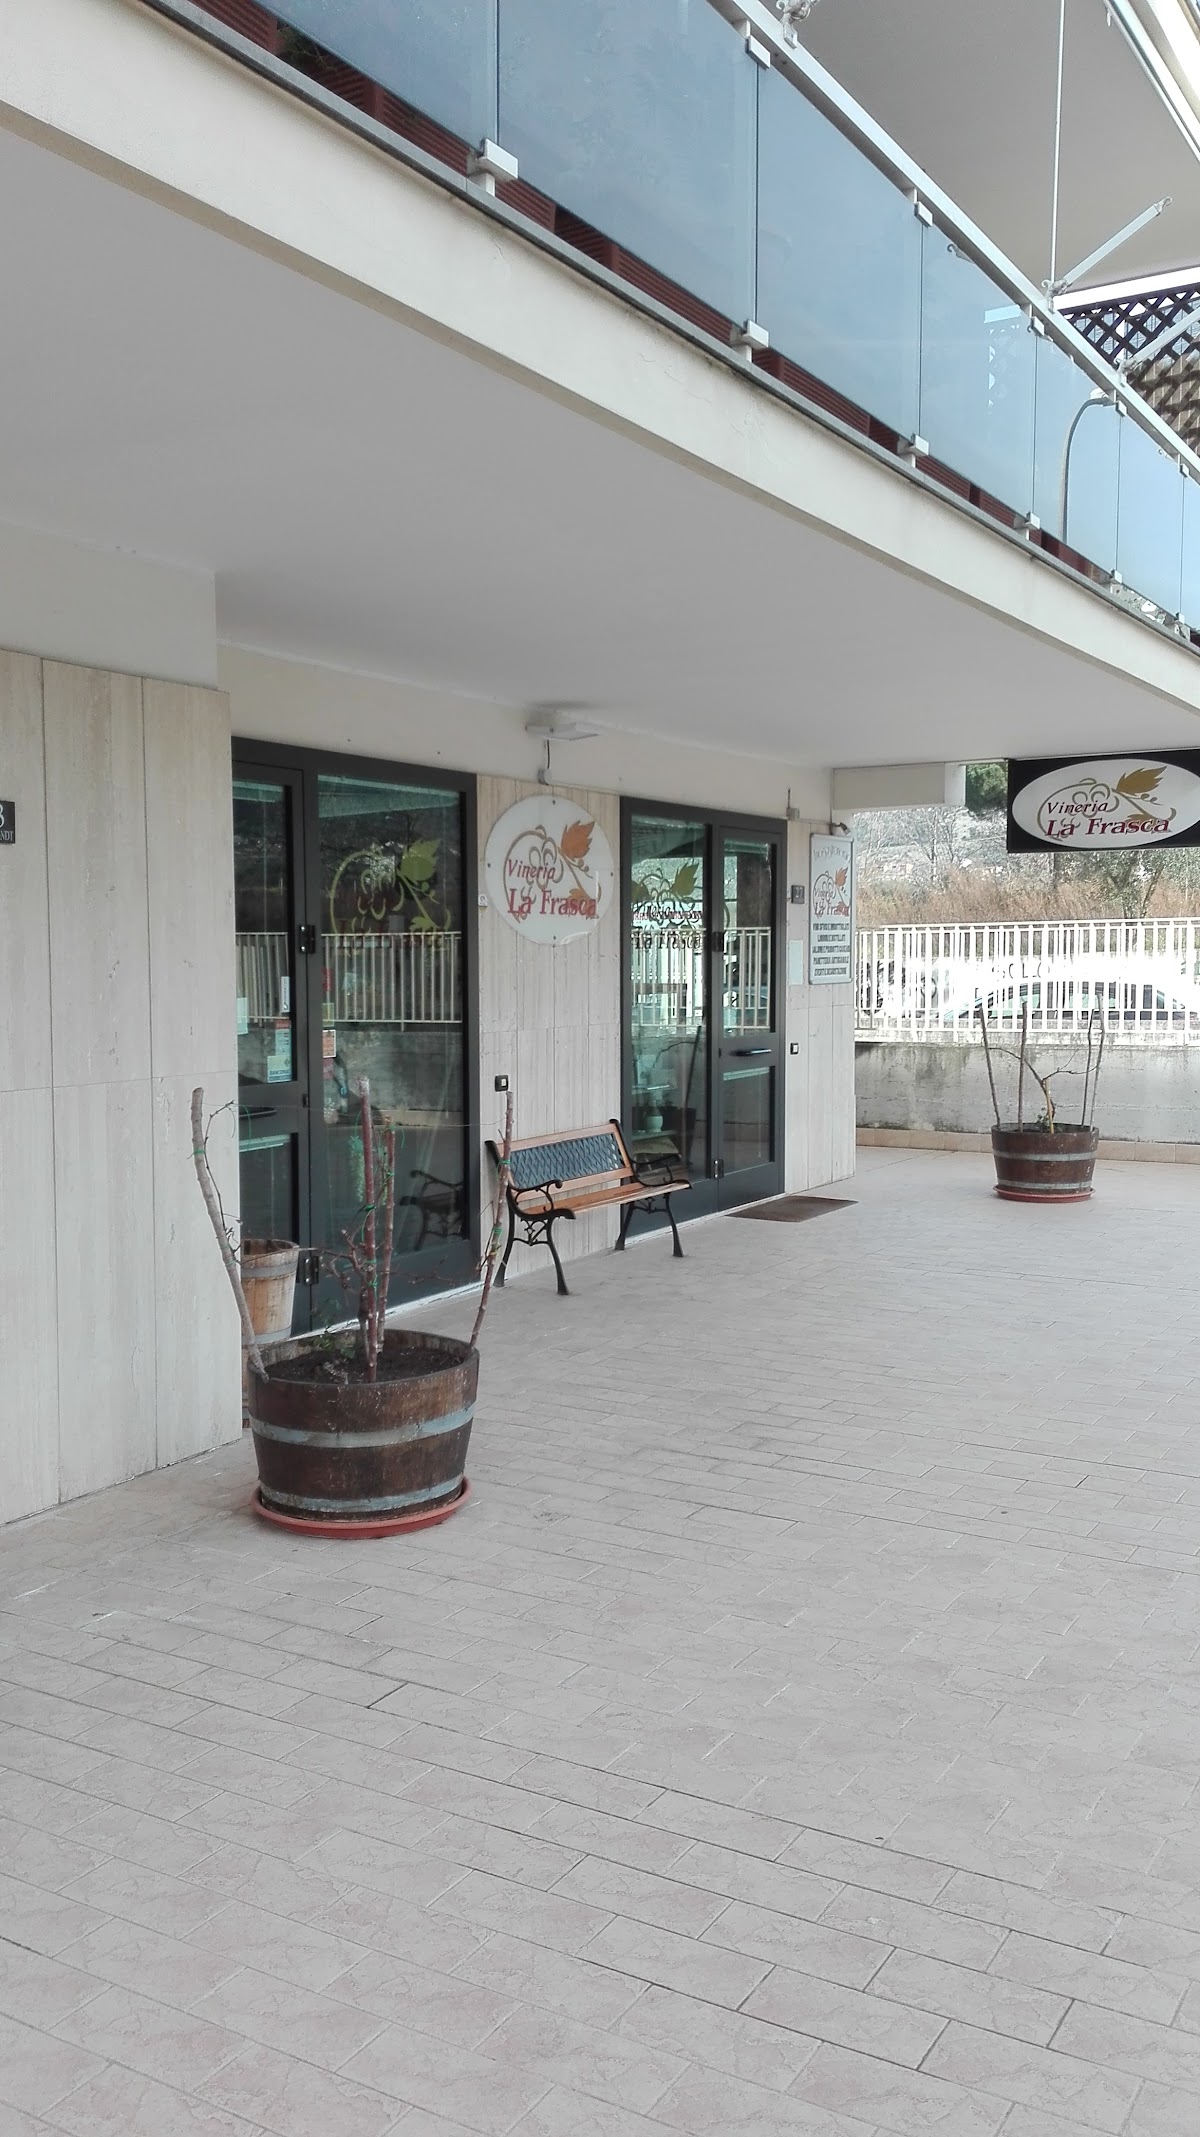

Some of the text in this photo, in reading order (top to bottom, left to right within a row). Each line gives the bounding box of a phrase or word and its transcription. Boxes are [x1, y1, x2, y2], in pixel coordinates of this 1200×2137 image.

[1047, 801, 1108, 814] Vineria
[1046, 818, 1170, 837] La Frasca
[507, 859, 556, 879] Vineria
[508, 888, 531, 915] La
[539, 889, 597, 916] Frasca
